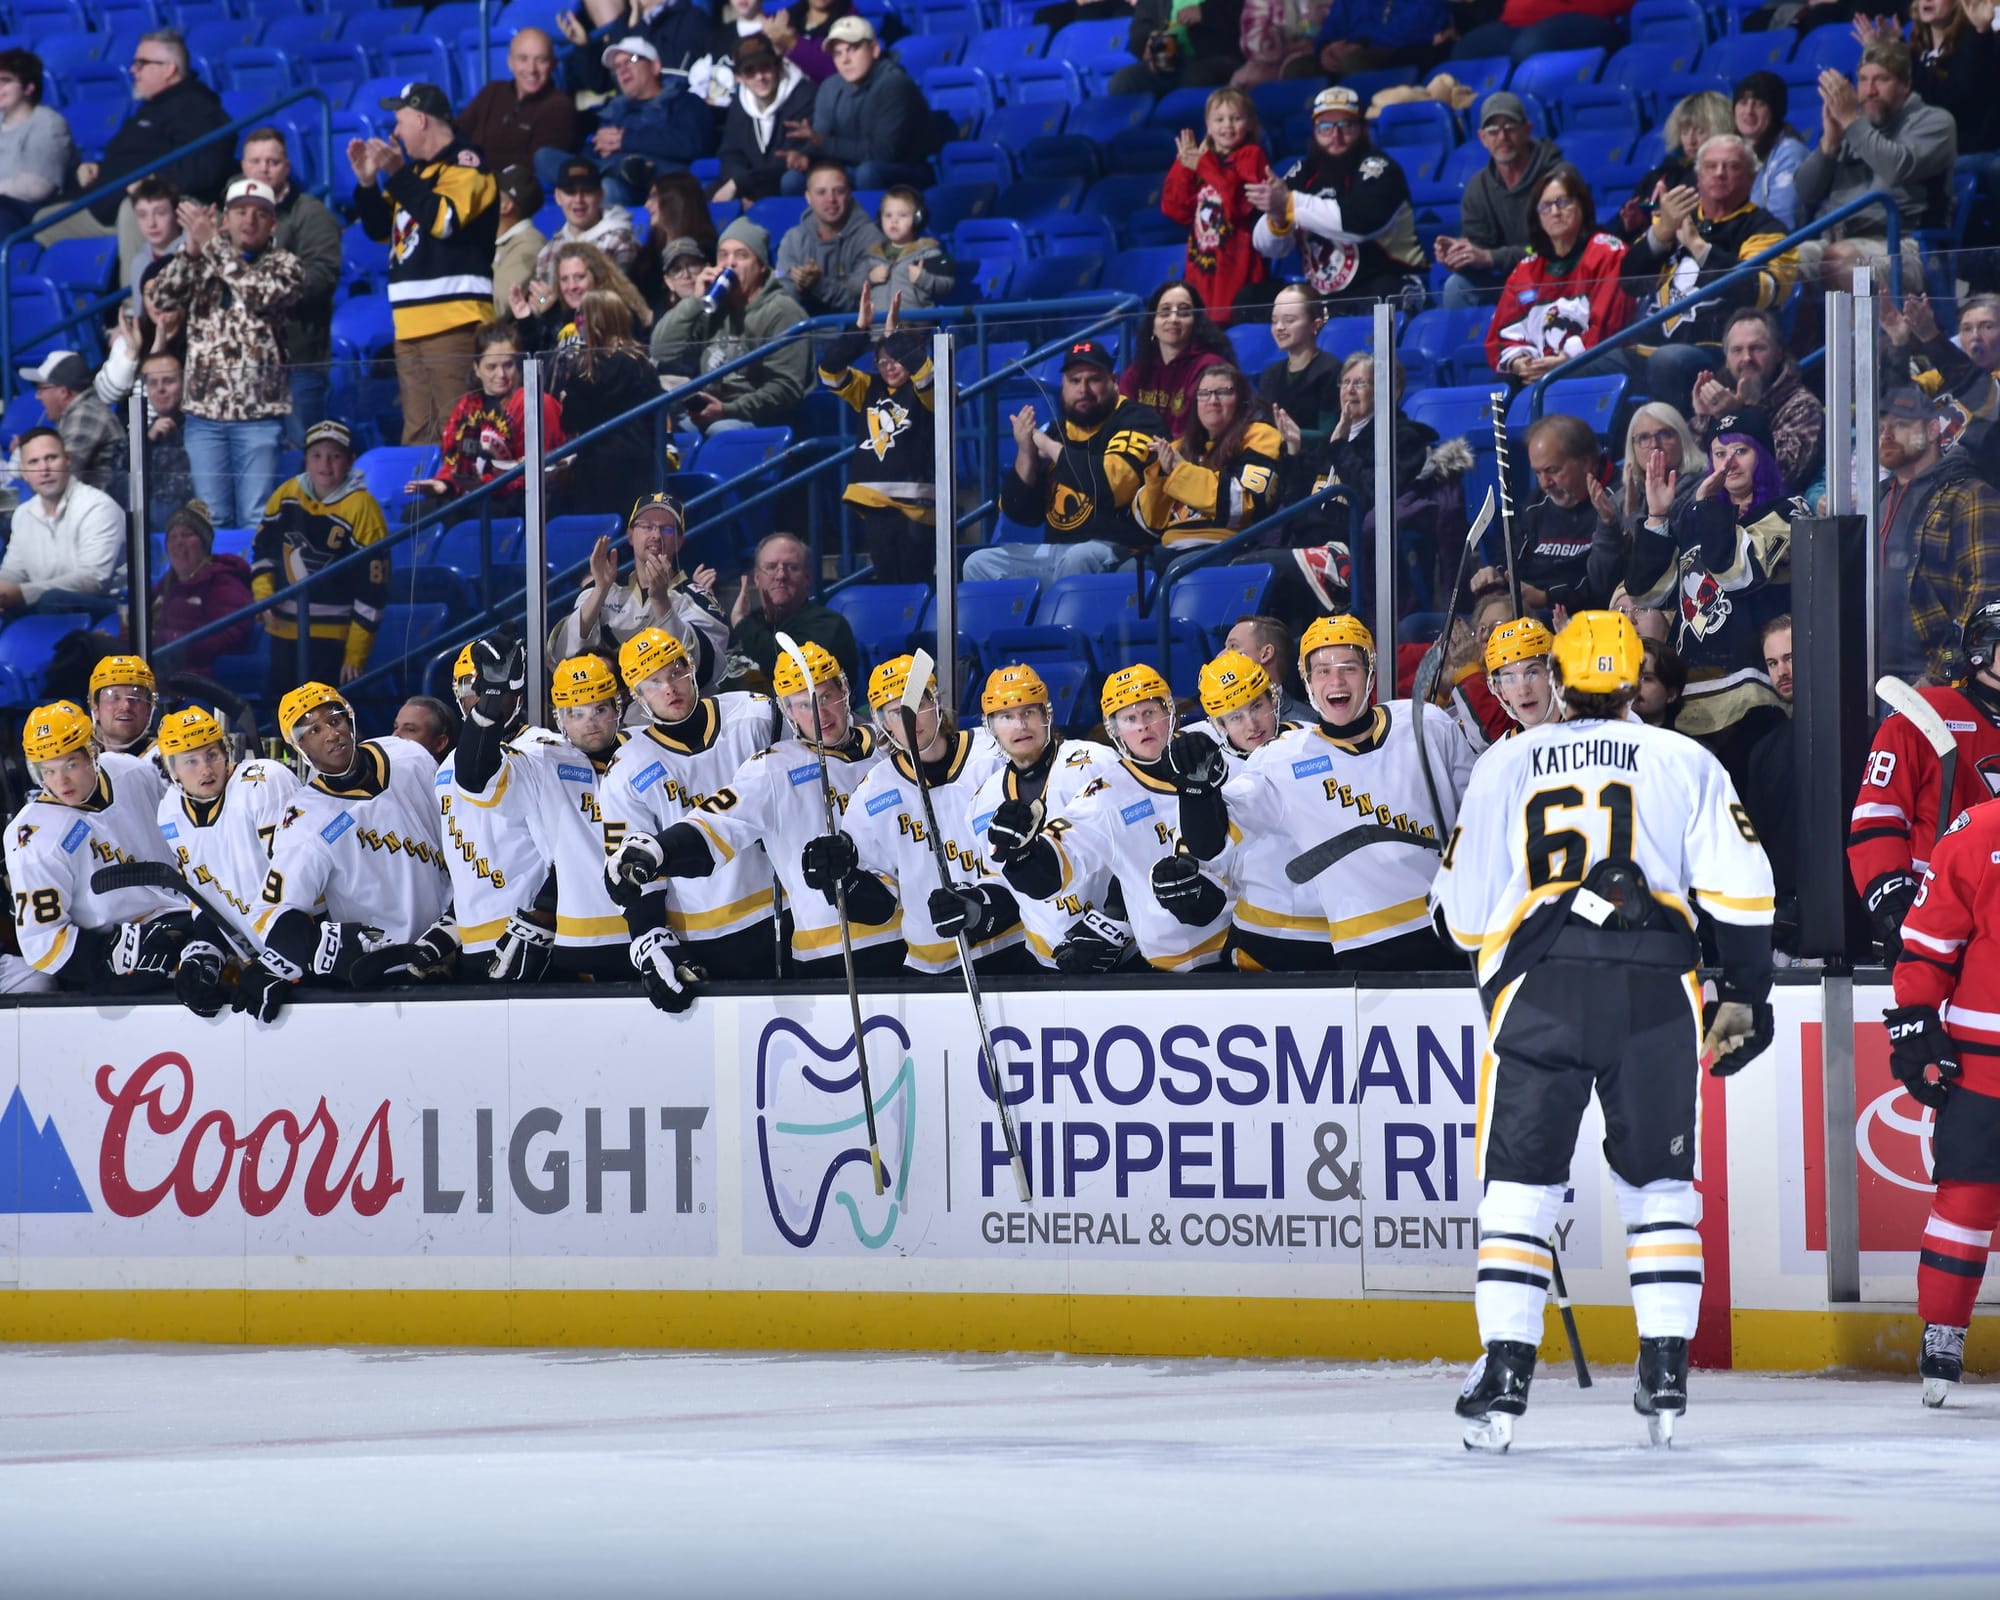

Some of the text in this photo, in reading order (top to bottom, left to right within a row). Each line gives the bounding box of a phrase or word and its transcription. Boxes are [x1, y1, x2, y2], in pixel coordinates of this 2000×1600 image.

[327, 525, 345, 549] C
[640, 650, 660, 666] CCM
[1597, 655, 1614, 672] 61
[572, 670, 588, 681] 44
[1219, 671, 1236, 685] 26
[1225, 685, 1248, 700] CCM
[36, 741, 58, 751] CCM
[37, 724, 50, 737] 78
[1294, 758, 1330, 774] Geisinger
[1532, 739, 1640, 778] KATCHOUK
[558, 767, 592, 783] Geisinger
[257, 824, 277, 860] 7
[1524, 780, 1634, 890] 61
[262, 868, 284, 905] 9
[16, 888, 63, 928] 78
[1085, 913, 1130, 945] CCM
[320, 921, 341, 973] CCM
[977, 1023, 1476, 1107] GROSSMAN
[95, 1051, 710, 1218] Coors LIGHT
[981, 1121, 1285, 1201] HIPPELI
[1307, 1121, 1366, 1201] &
[982, 1210, 1140, 1246] GENERAL
[1148, 1212, 1171, 1246] &
[1180, 1212, 1361, 1248] COSMETIC
